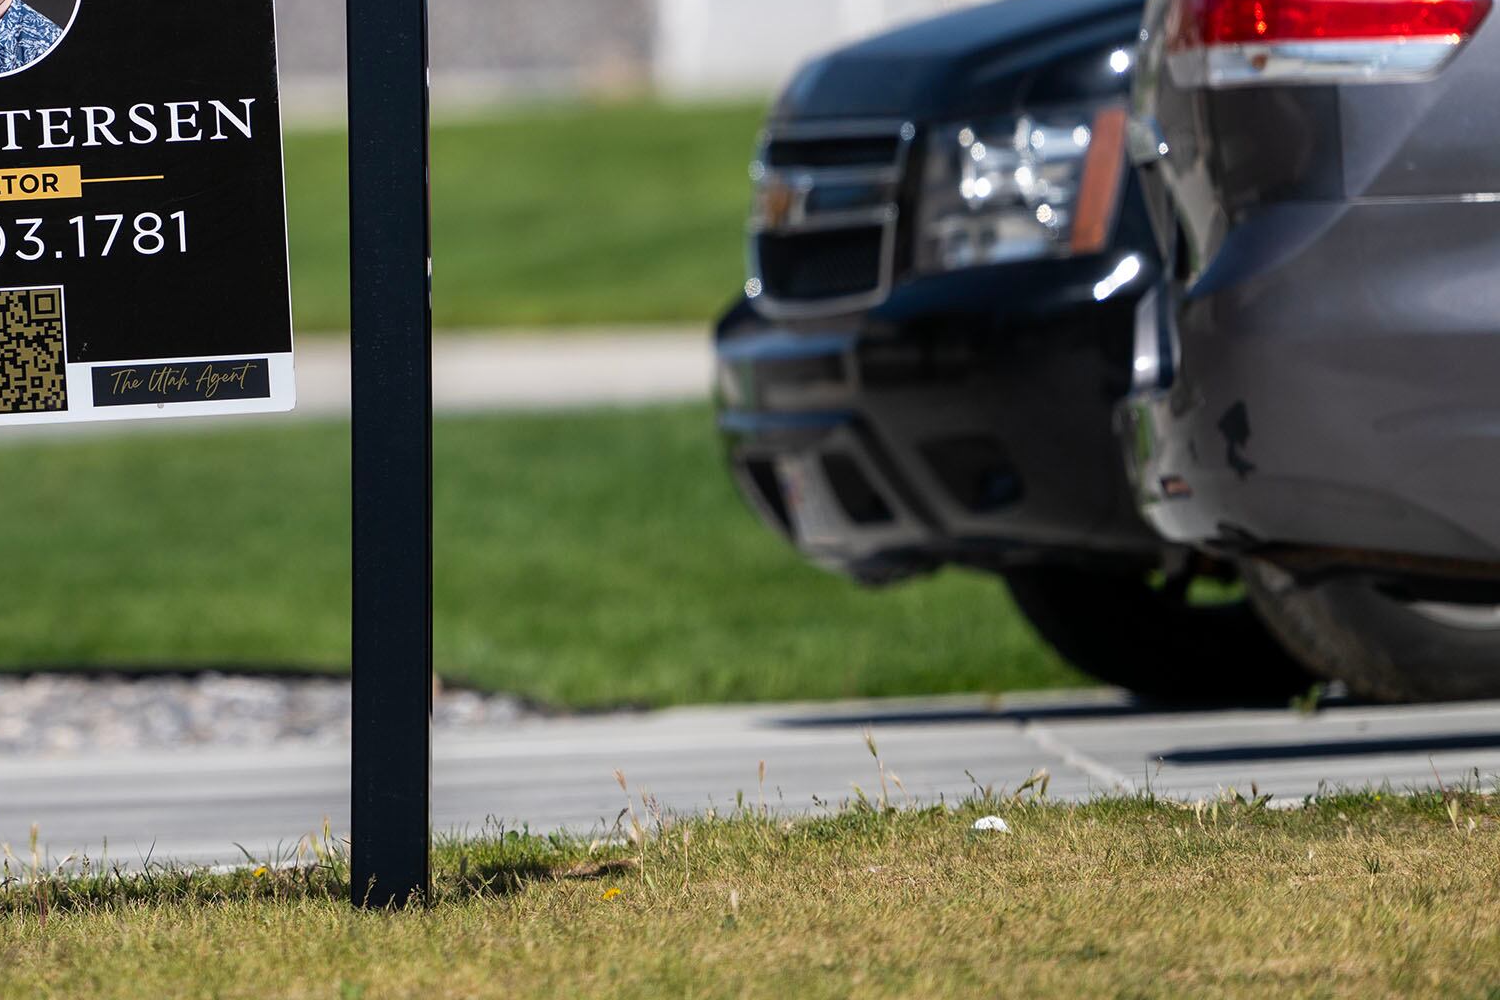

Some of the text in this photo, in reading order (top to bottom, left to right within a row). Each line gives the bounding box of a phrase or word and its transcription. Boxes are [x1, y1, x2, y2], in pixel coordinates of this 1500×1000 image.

[111, 363, 257, 398] The Utah Agent
